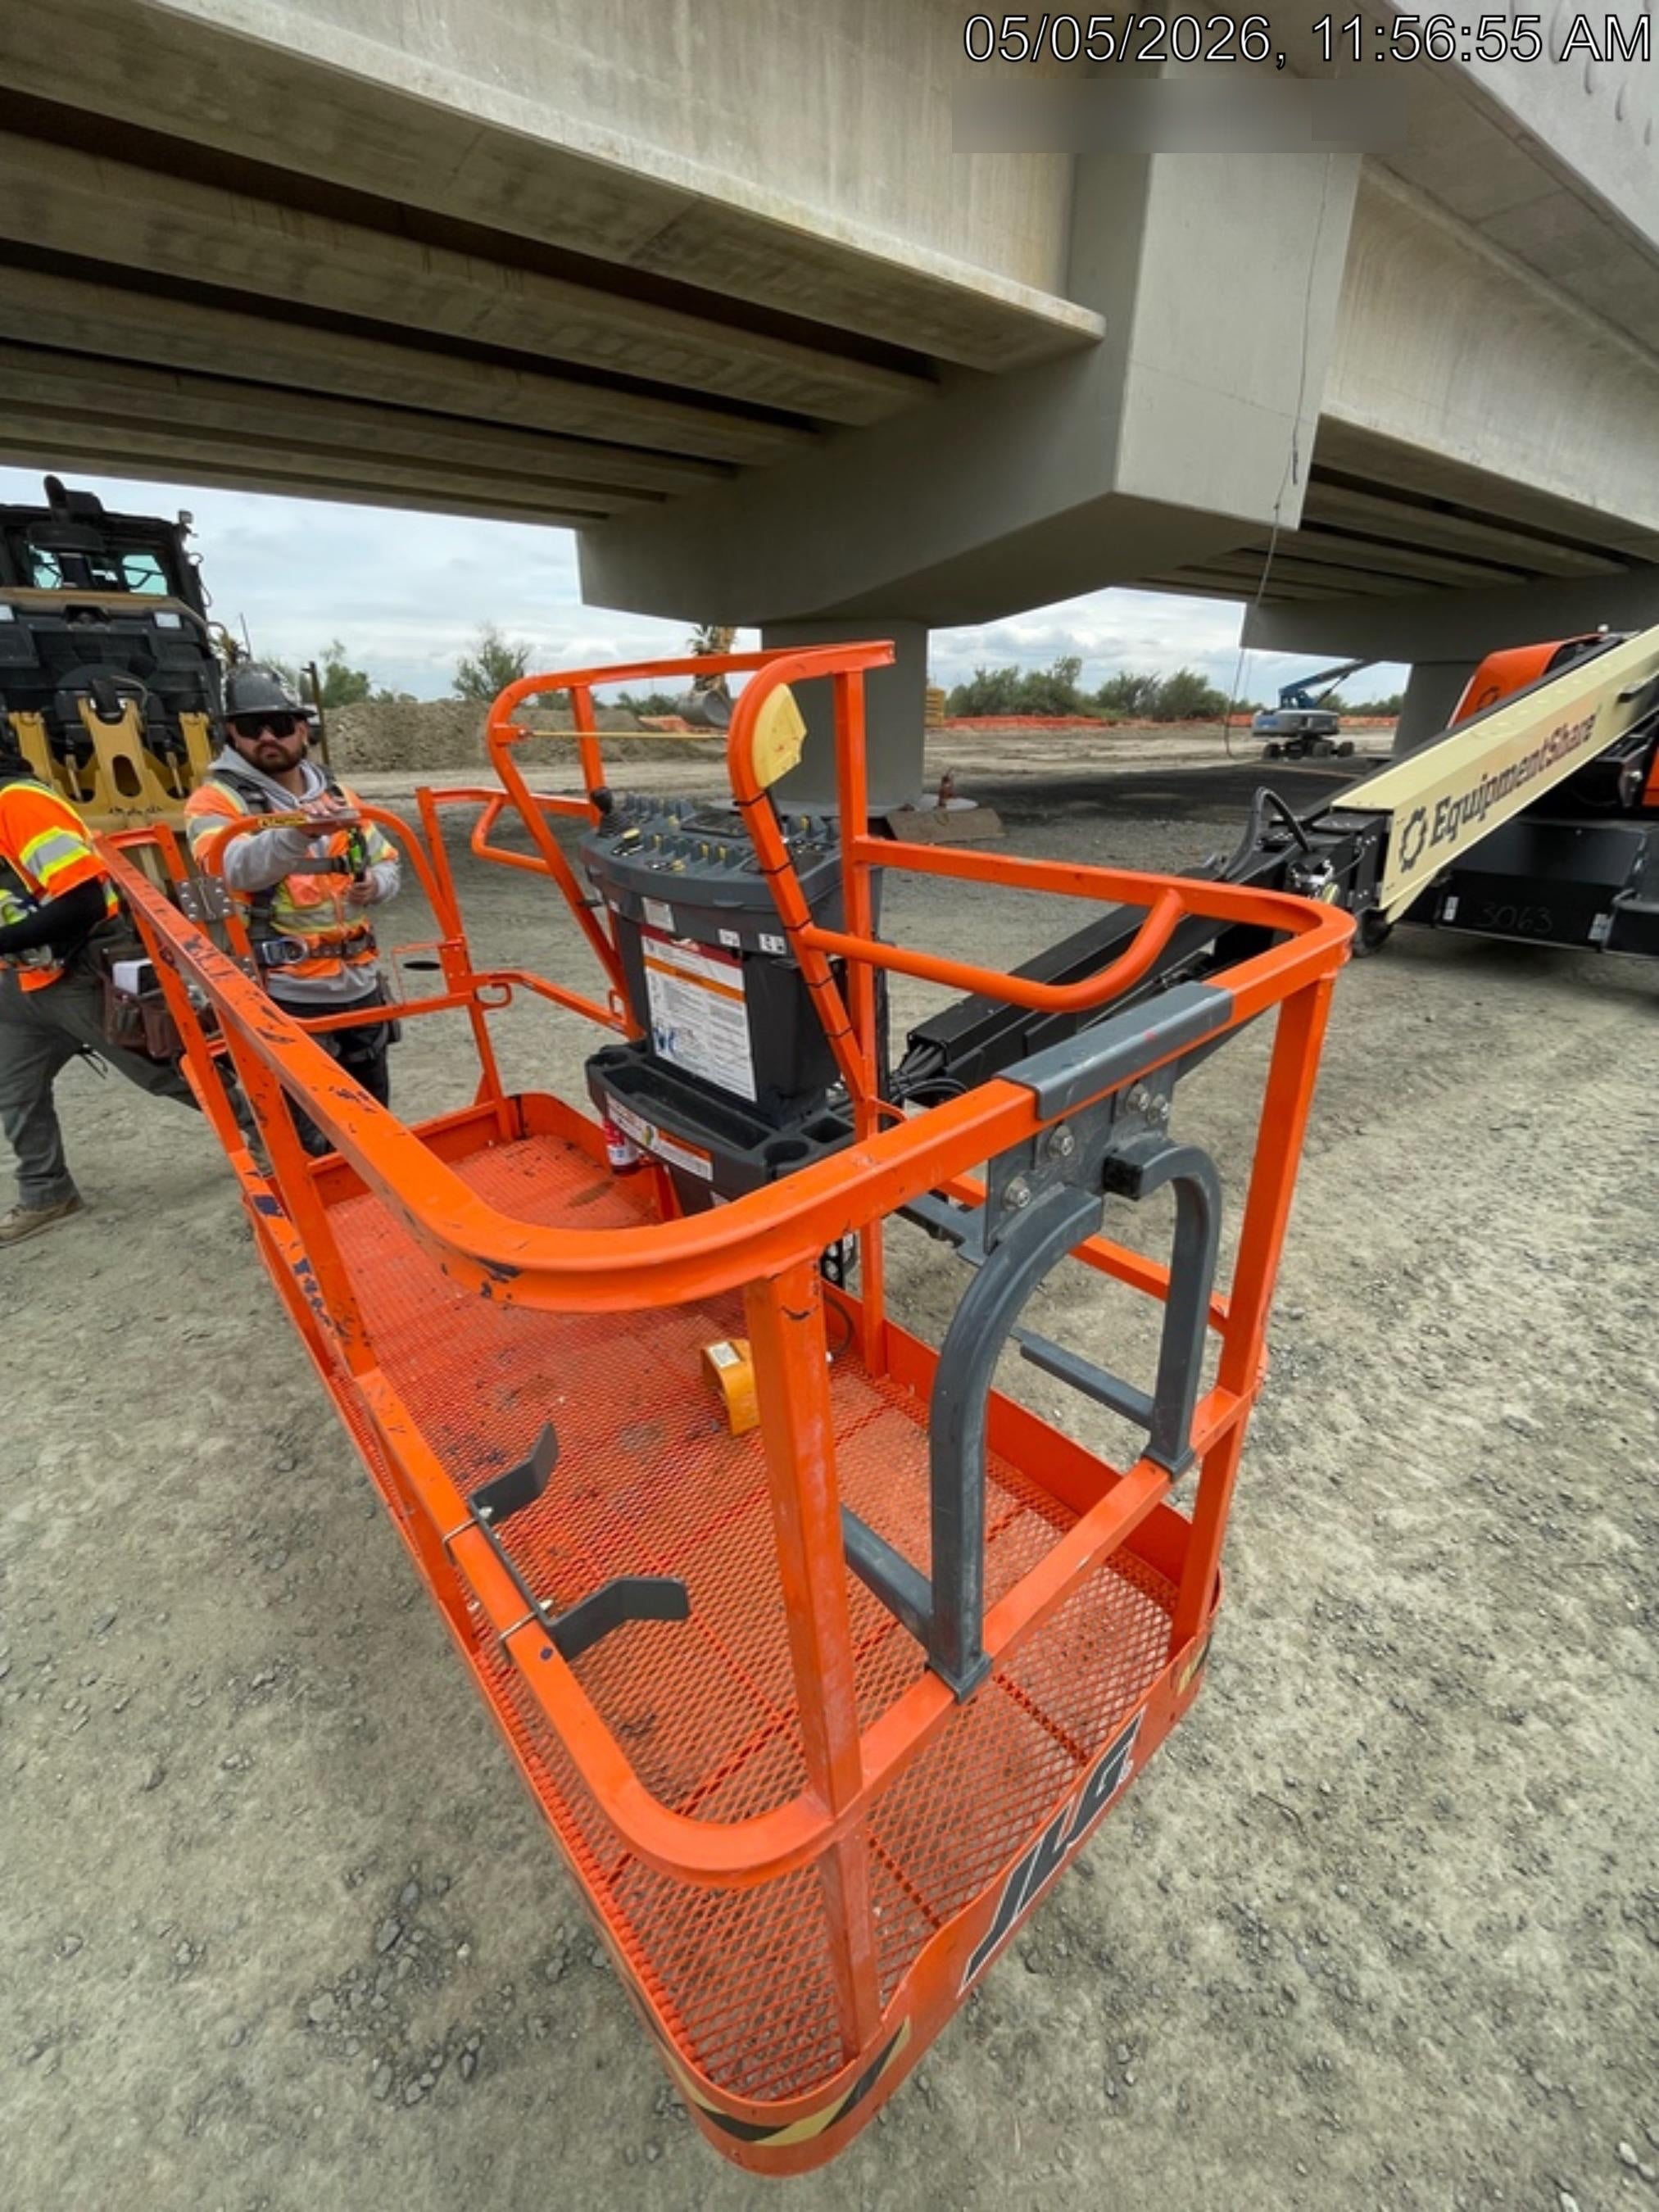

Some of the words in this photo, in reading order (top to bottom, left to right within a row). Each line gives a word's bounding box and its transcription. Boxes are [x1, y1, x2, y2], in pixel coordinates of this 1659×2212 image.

[1429, 714, 1595, 846] EquipmentShare
[1475, 901, 1553, 934] 3063
[956, 1704, 1146, 1997] JLG
